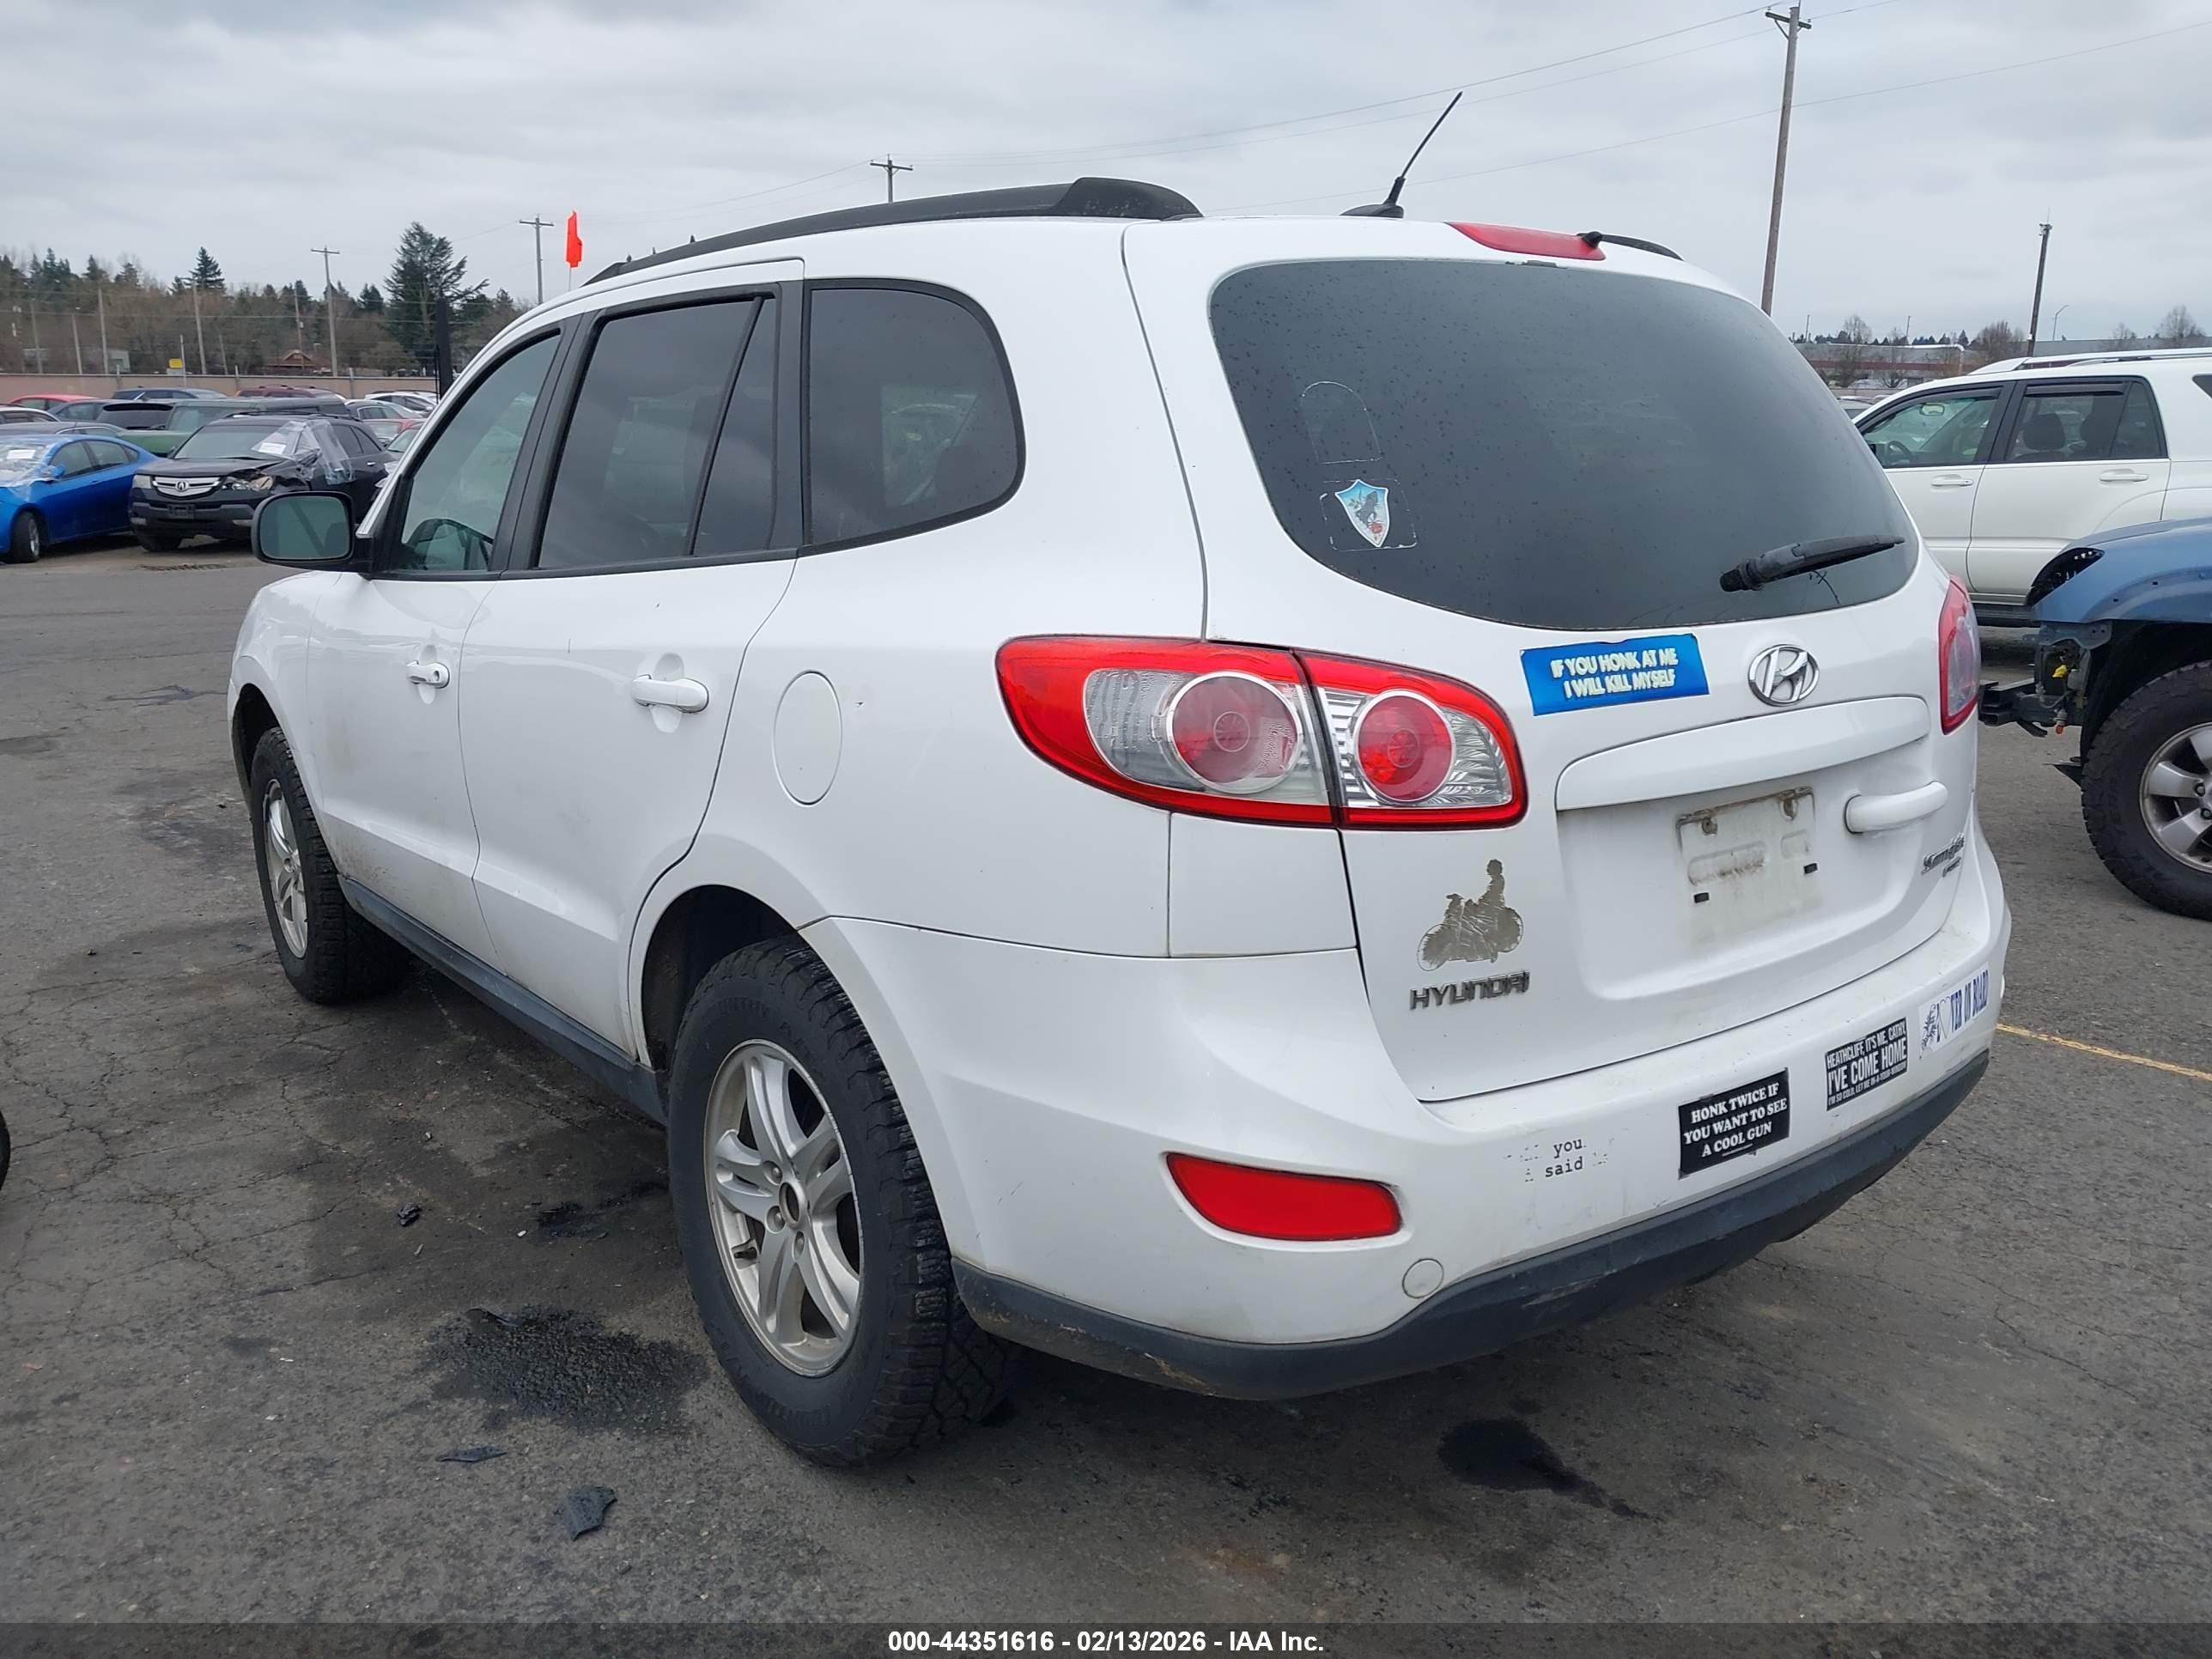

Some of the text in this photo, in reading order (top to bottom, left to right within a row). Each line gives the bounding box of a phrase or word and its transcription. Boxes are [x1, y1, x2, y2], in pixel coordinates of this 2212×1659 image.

[1550, 647, 1678, 678] IF YOU HONK AT ME
[1564, 669, 1676, 698] I WILL KILL MYSELF
[1409, 969, 1530, 1010] HYUNDAI
[1826, 1040, 1865, 1069] HEATHCLIFF,
[1864, 1035, 1877, 1053] IT'S
[1828, 1036, 1907, 1096] I'VE COME HOME
[1691, 1083, 1779, 1124] HONK TWICE IF
[1683, 1098, 1787, 1145] YOU WANT TO SEE
[1702, 1121, 1772, 1157] A COOL GUN
[1553, 1139, 1583, 1158] you
[1546, 1156, 1583, 1177] said
